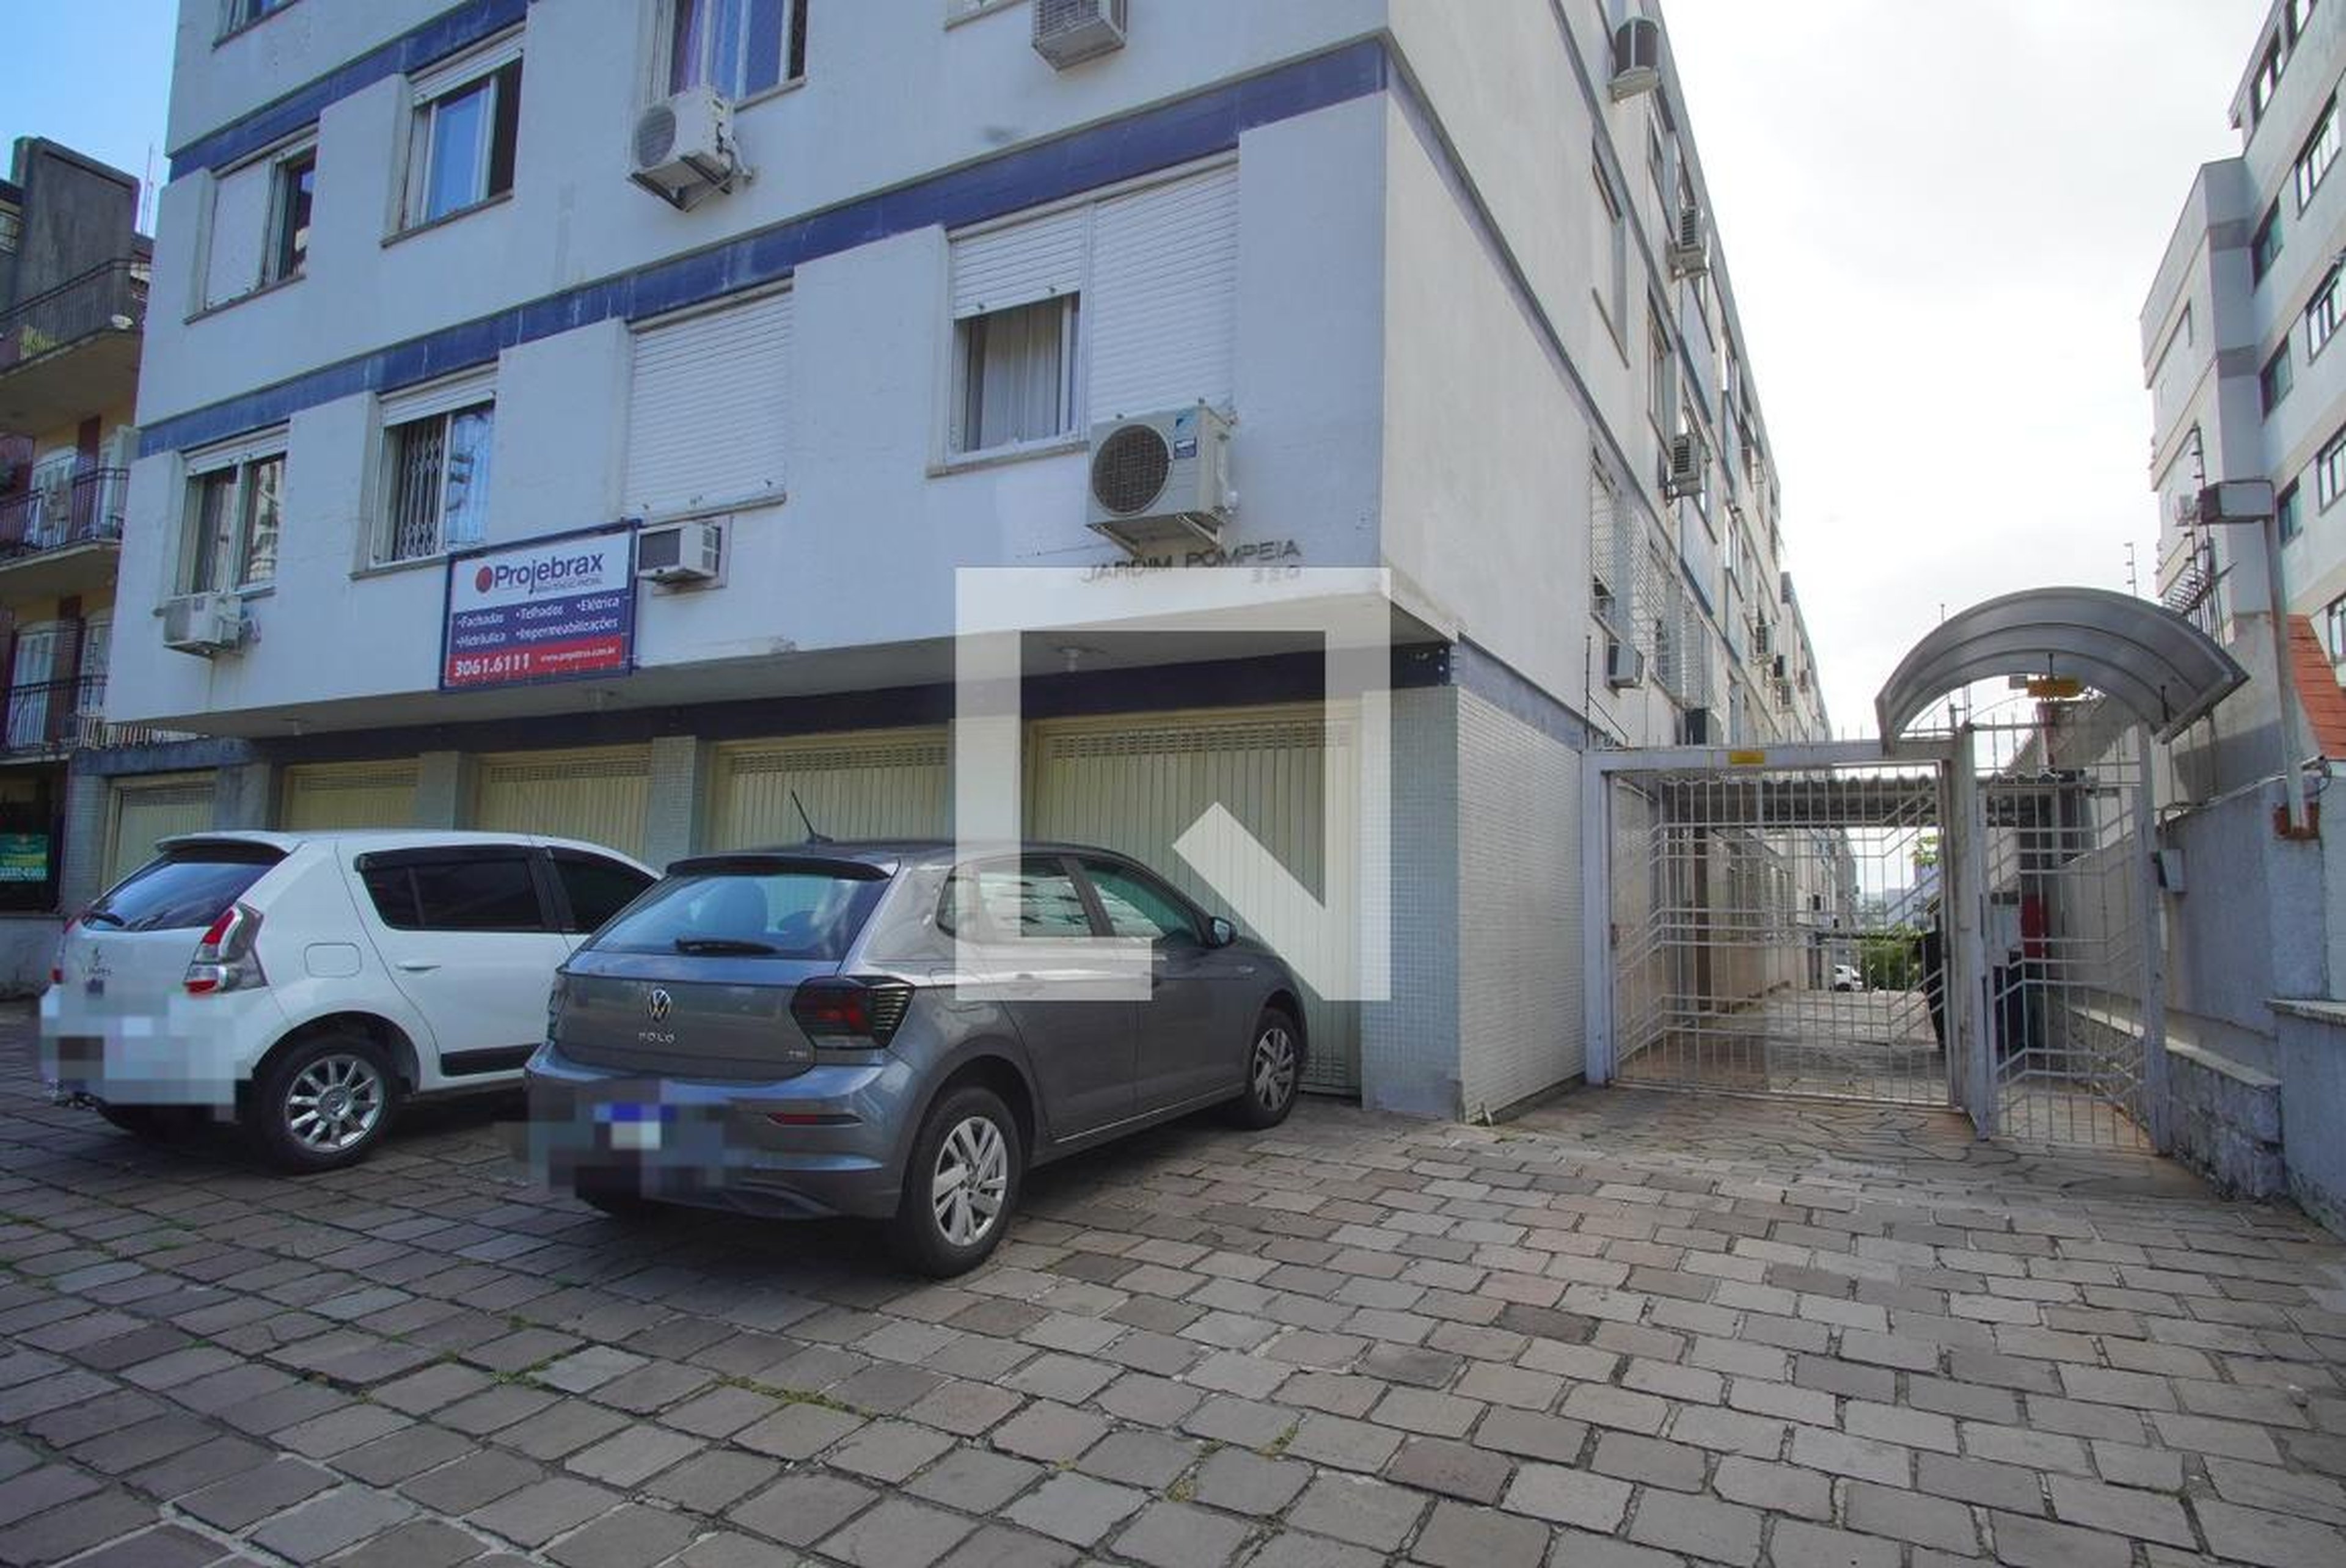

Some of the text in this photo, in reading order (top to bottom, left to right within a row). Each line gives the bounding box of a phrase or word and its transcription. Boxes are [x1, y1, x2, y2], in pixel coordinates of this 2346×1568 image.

[1078, 539, 1302, 583] JARDIM POMPEIA
[494, 553, 604, 594] Projebrax
[521, 604, 565, 619] Telhados
[455, 653, 530, 676] 3061.6111
[638, 1032, 674, 1043] POLO
